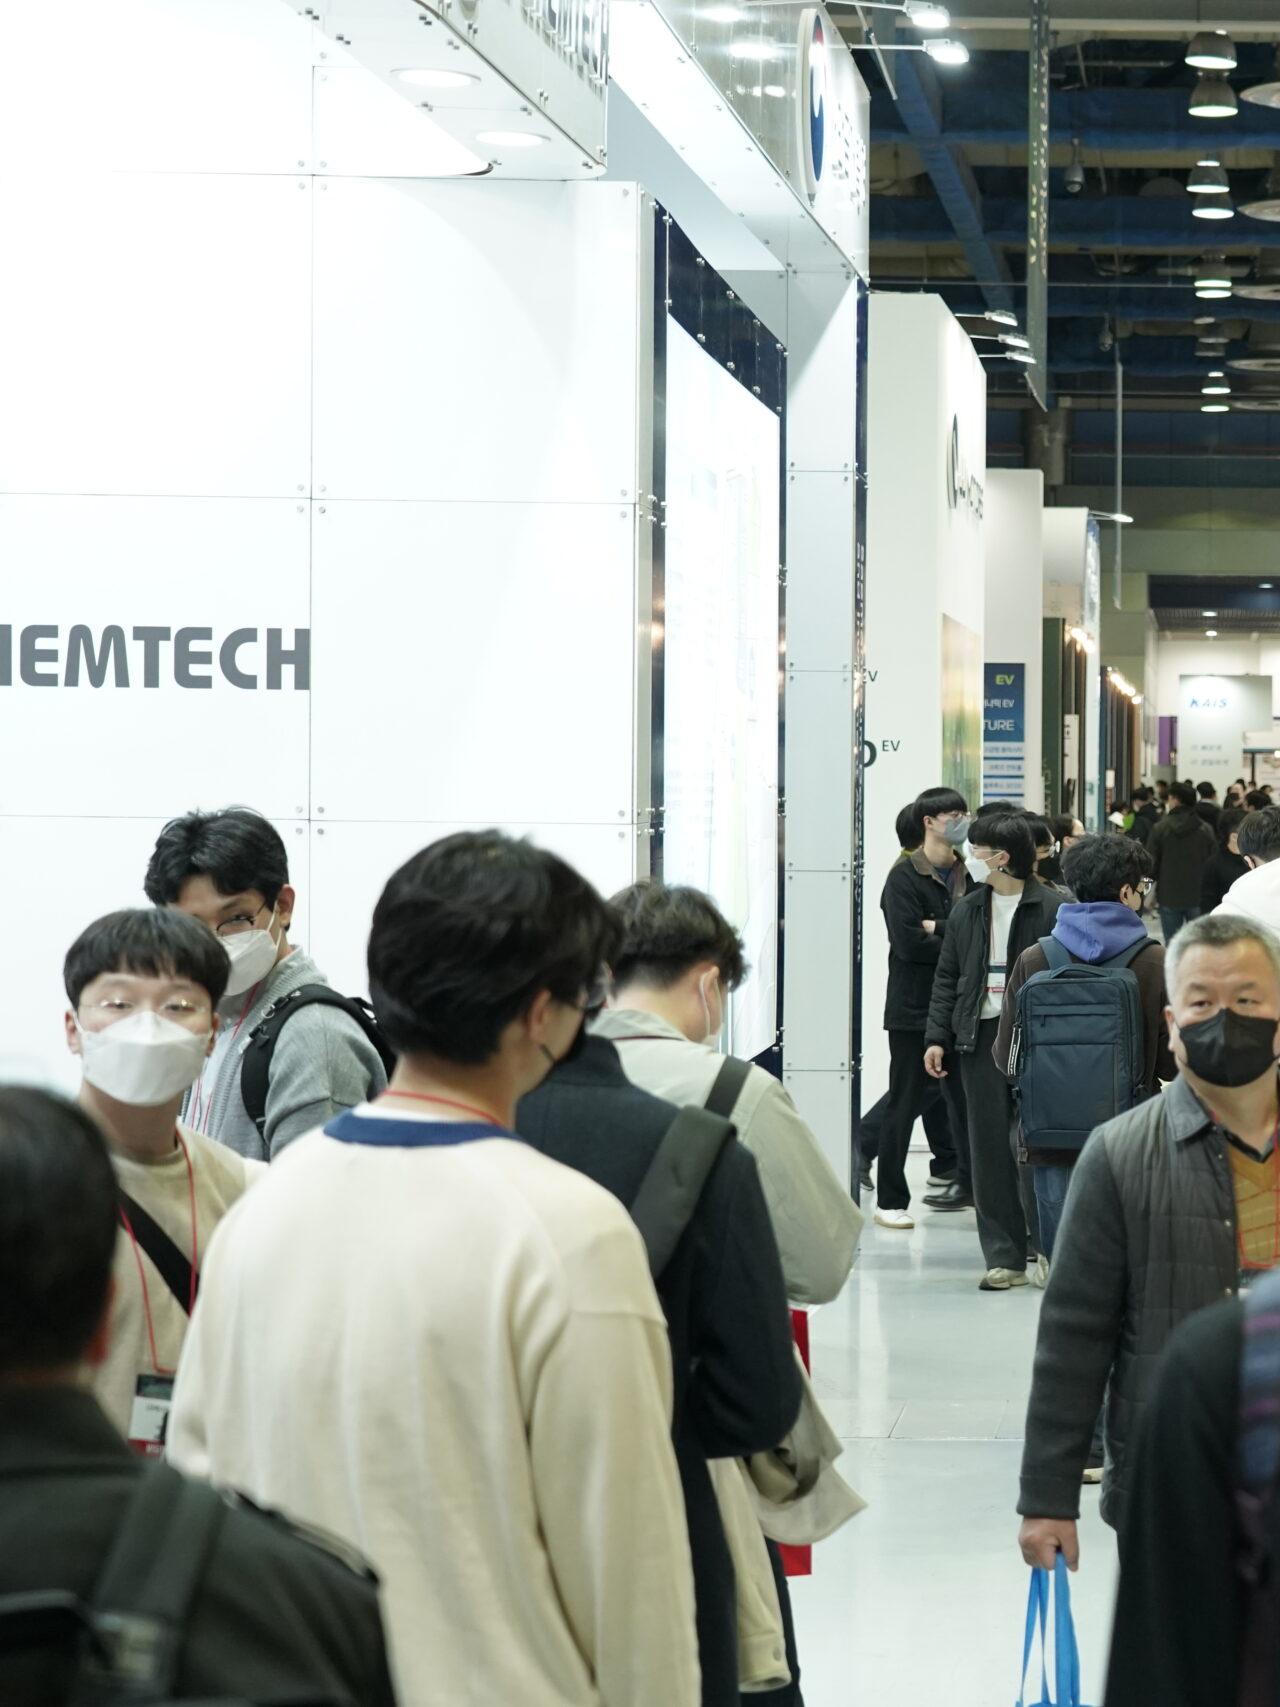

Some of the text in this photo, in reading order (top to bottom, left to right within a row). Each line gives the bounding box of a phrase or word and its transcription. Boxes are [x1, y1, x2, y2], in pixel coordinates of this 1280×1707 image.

[0, 624, 310, 691] EMTECH
[995, 675, 1015, 686] EV
[881, 739, 901, 752] EV
